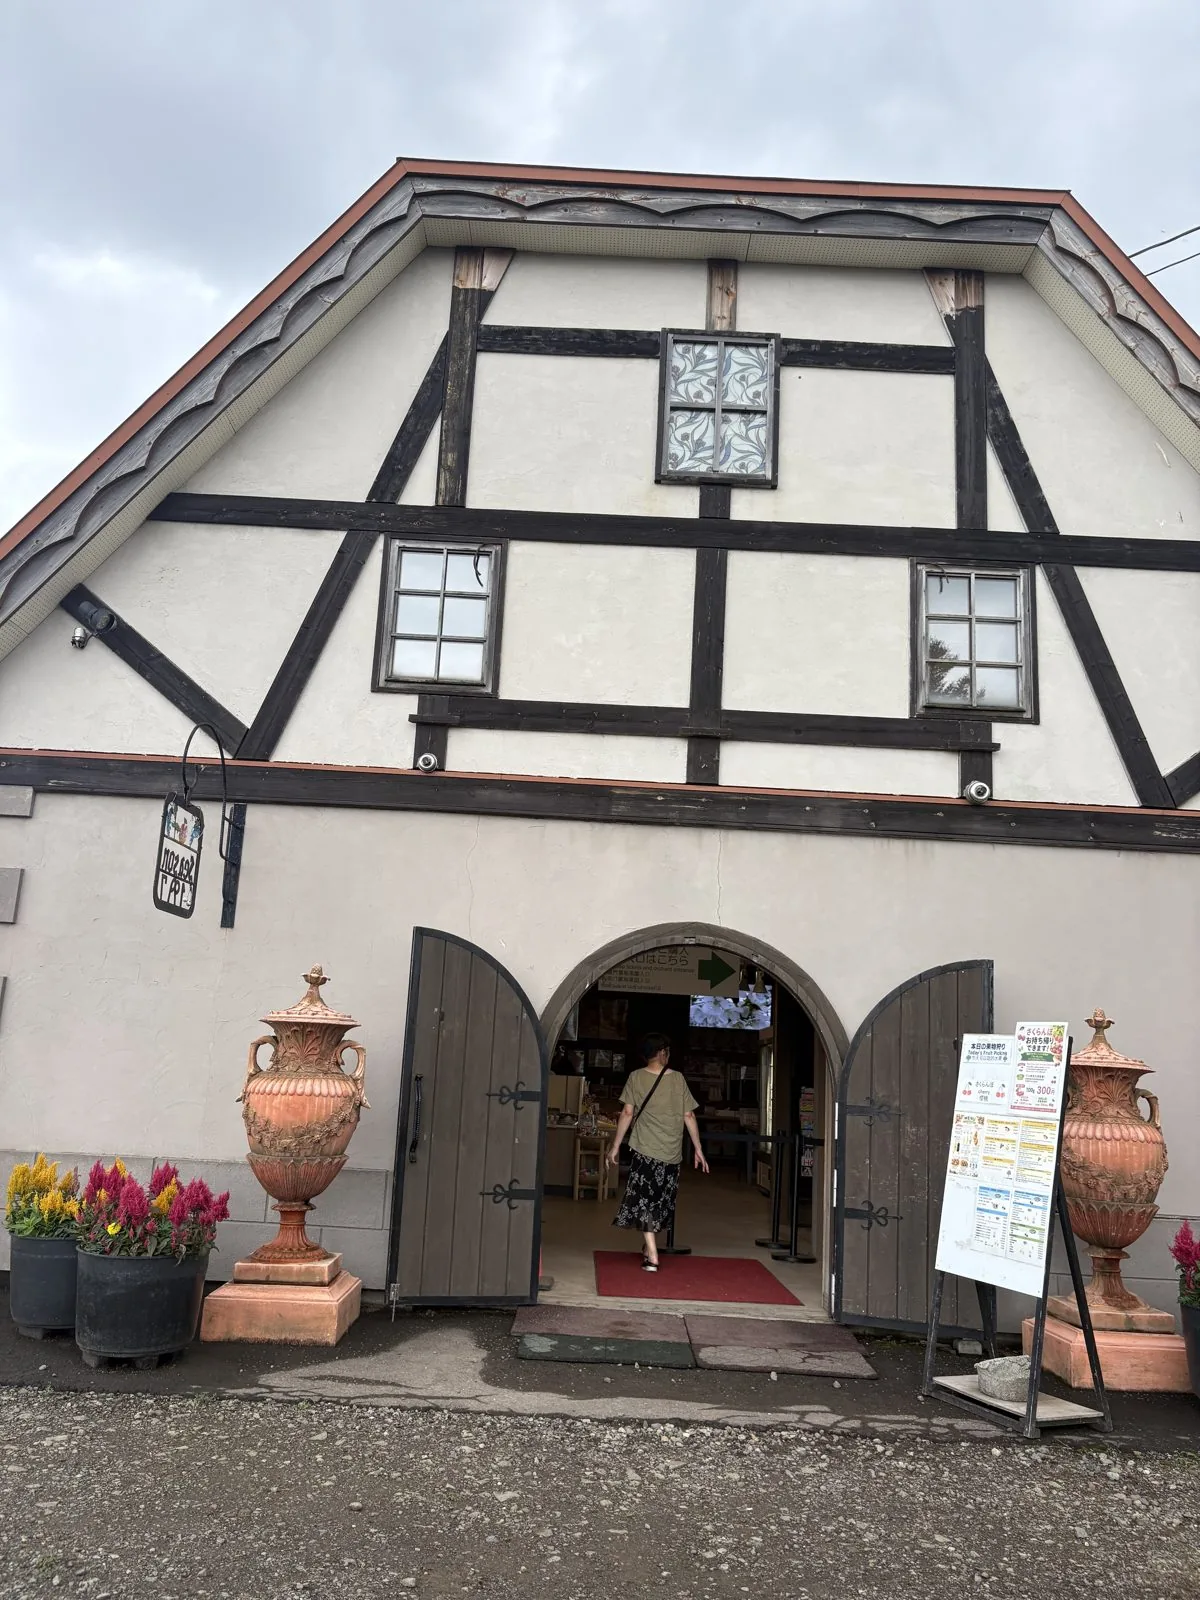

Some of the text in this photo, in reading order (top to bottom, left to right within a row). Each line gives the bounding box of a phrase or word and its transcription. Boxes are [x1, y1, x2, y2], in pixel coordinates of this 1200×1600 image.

[1026, 1027, 1053, 1036] さくらんぼ
[1025, 1037, 1054, 1045] お持ち帰り
